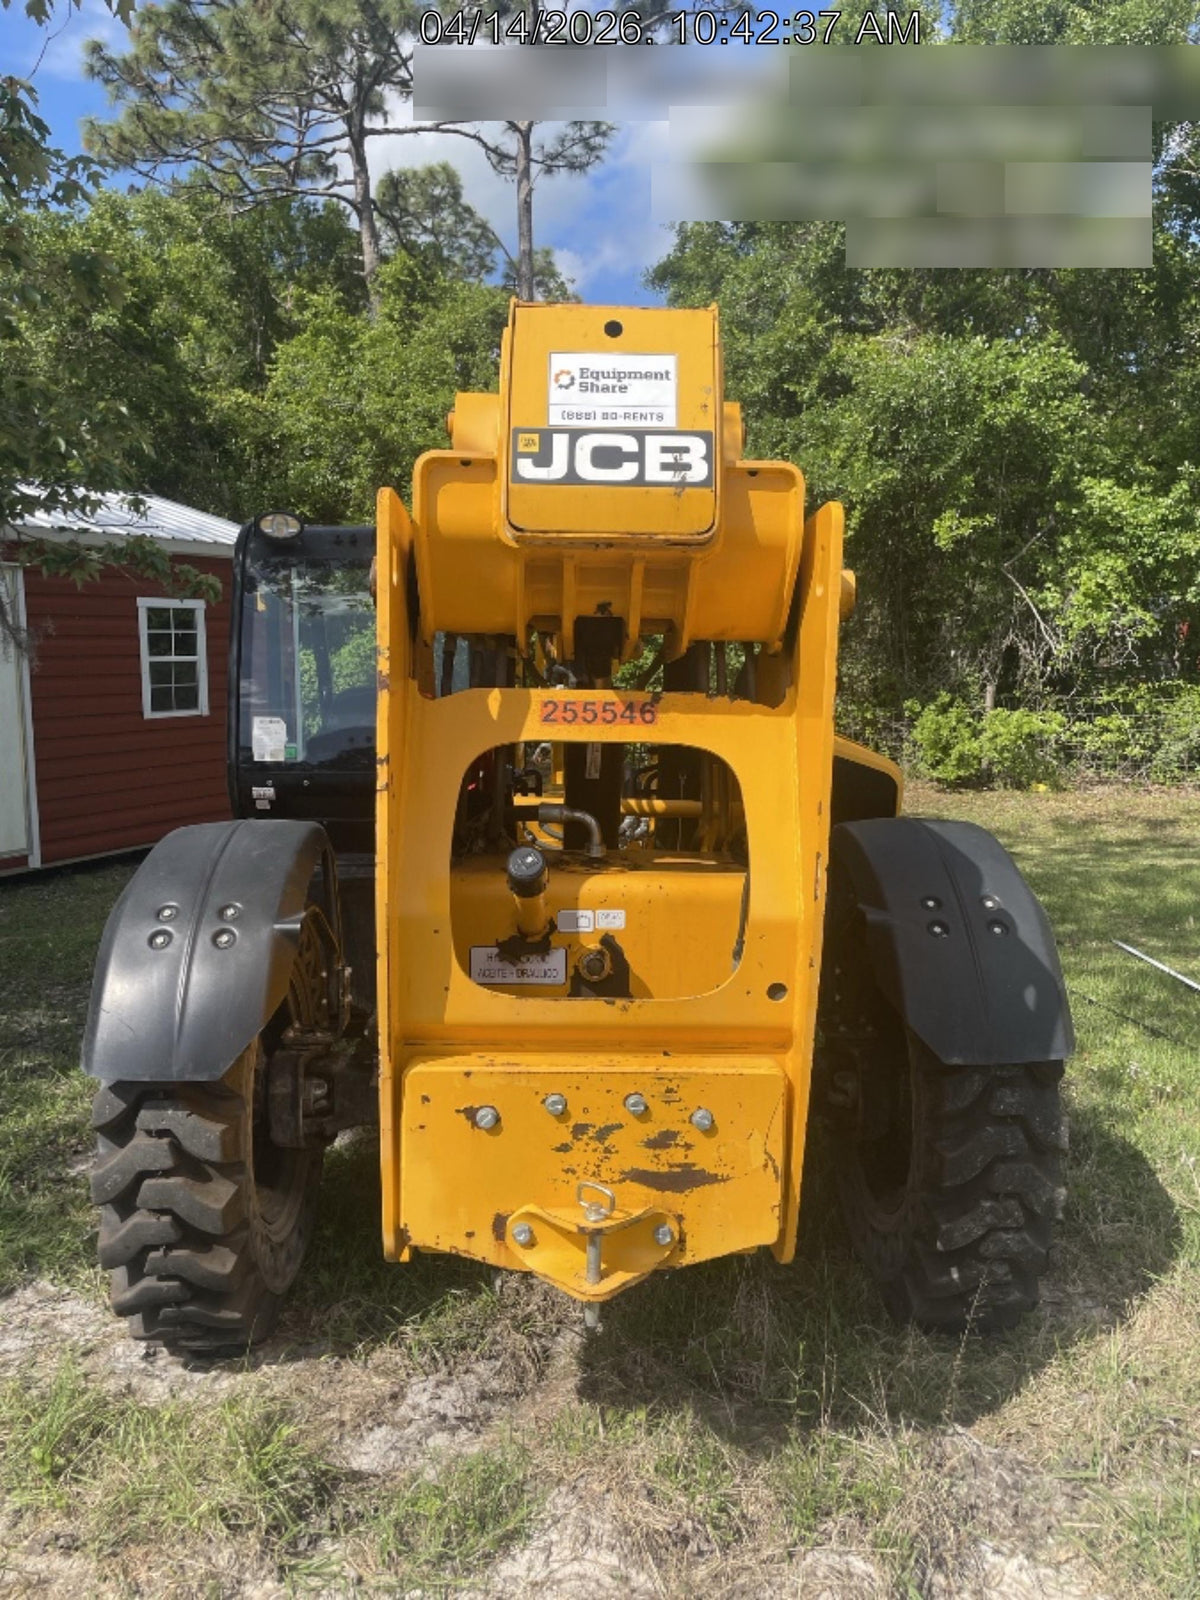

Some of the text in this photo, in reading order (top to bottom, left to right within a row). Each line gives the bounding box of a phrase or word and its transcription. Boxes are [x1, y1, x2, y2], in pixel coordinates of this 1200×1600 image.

[578, 367, 671, 383] Equipment
[578, 382, 629, 394] Share
[516, 433, 709, 483] JCB
[541, 700, 656, 724] 255546
